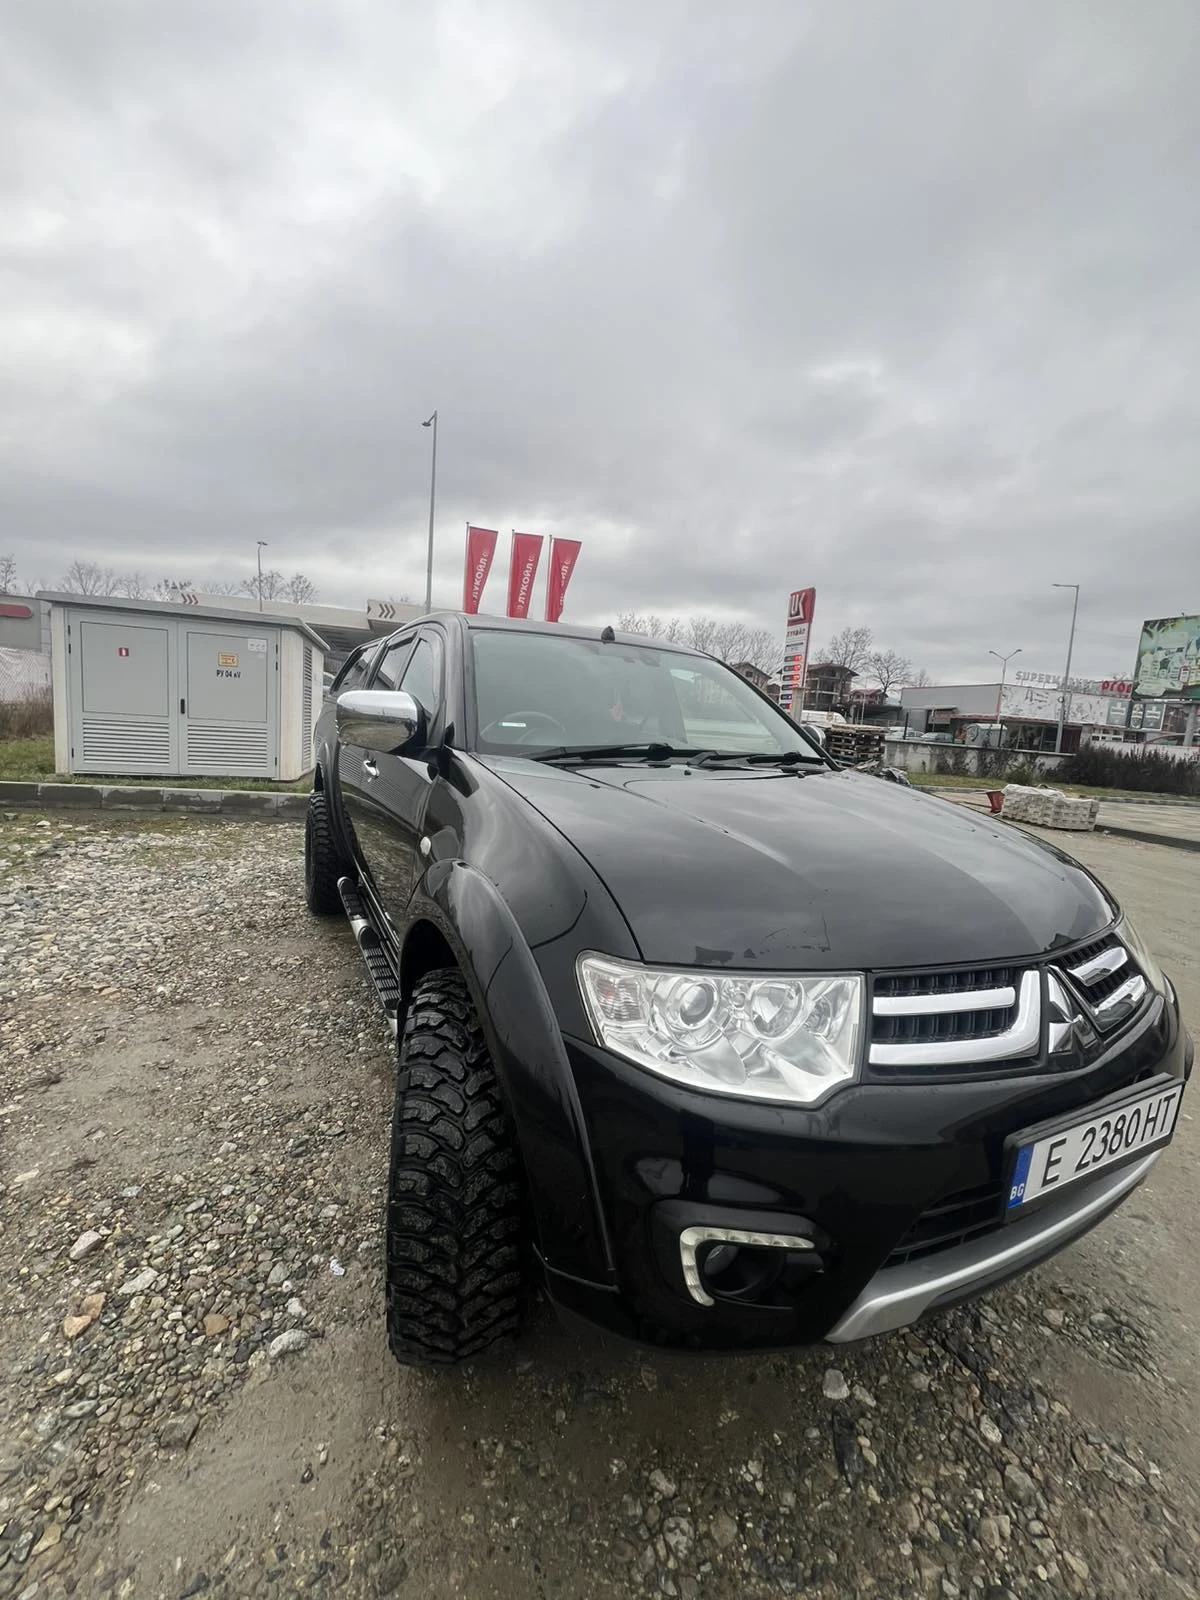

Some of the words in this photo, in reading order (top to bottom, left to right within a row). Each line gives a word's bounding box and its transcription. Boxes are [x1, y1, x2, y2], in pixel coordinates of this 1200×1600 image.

[472, 557, 489, 599] ЛУКОЙЛ
[518, 562, 534, 605] ЛУКОЙЛ
[1041, 1138, 1067, 1188] E
[1074, 1108, 1141, 1173] 2380
[1140, 1093, 1176, 1142] HT
[1009, 1183, 1025, 1200] BG
